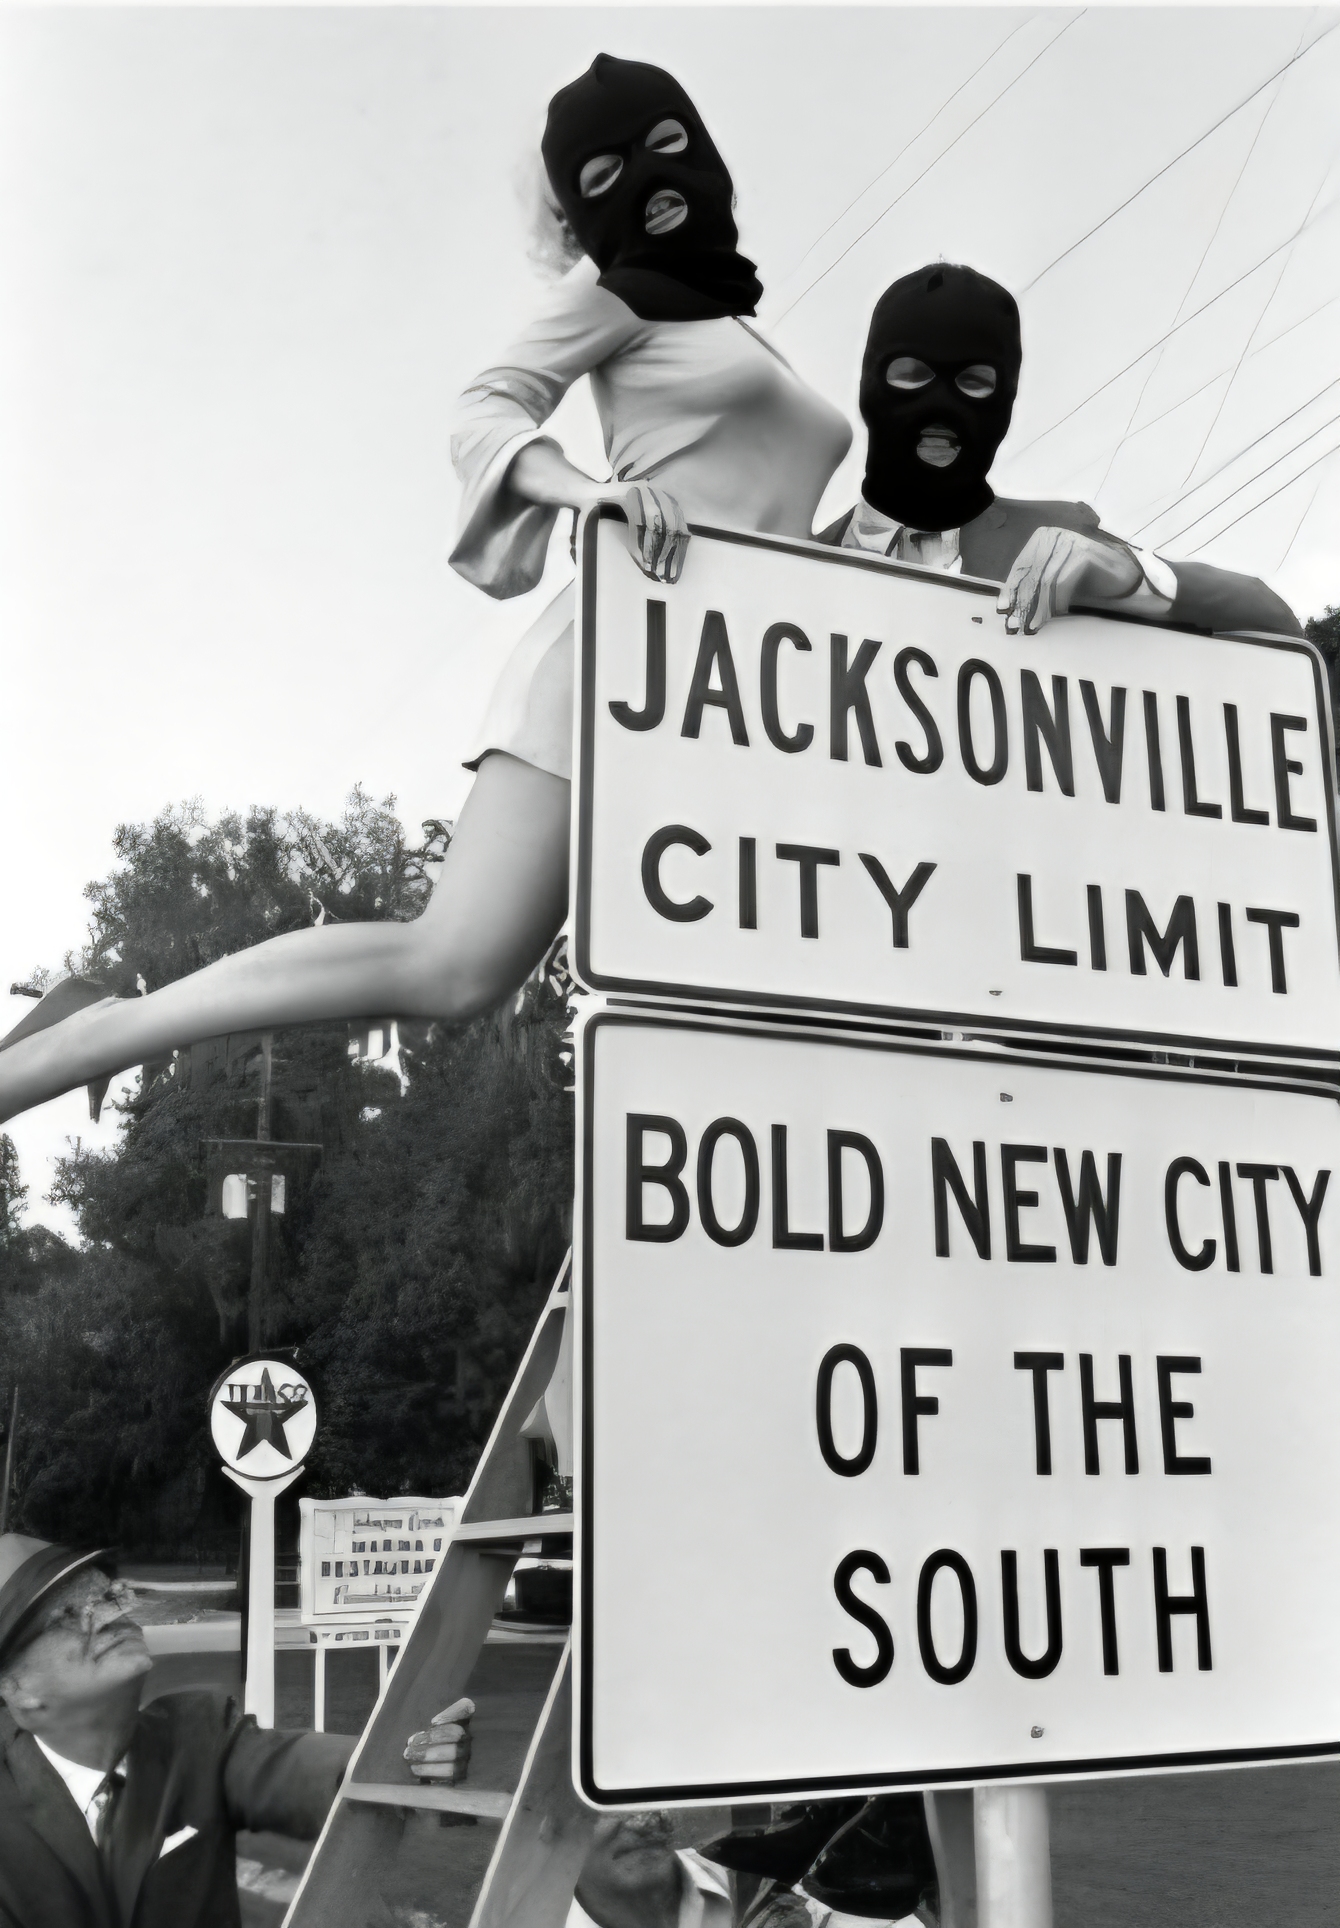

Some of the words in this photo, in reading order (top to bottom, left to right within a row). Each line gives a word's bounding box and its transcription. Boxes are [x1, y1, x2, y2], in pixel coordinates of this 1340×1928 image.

[608, 598, 1318, 833] JACKSONVILLE
[640, 824, 938, 950] CITY
[1016, 873, 1300, 995] LIMIT
[625, 1112, 885, 1253] BOLD
[931, 1136, 1123, 1267] NEW
[1164, 1156, 1332, 1277] CITY
[815, 1342, 953, 1478] OF
[1013, 1351, 1212, 1476] THE
[832, 1545, 1213, 1689] SOUTH
